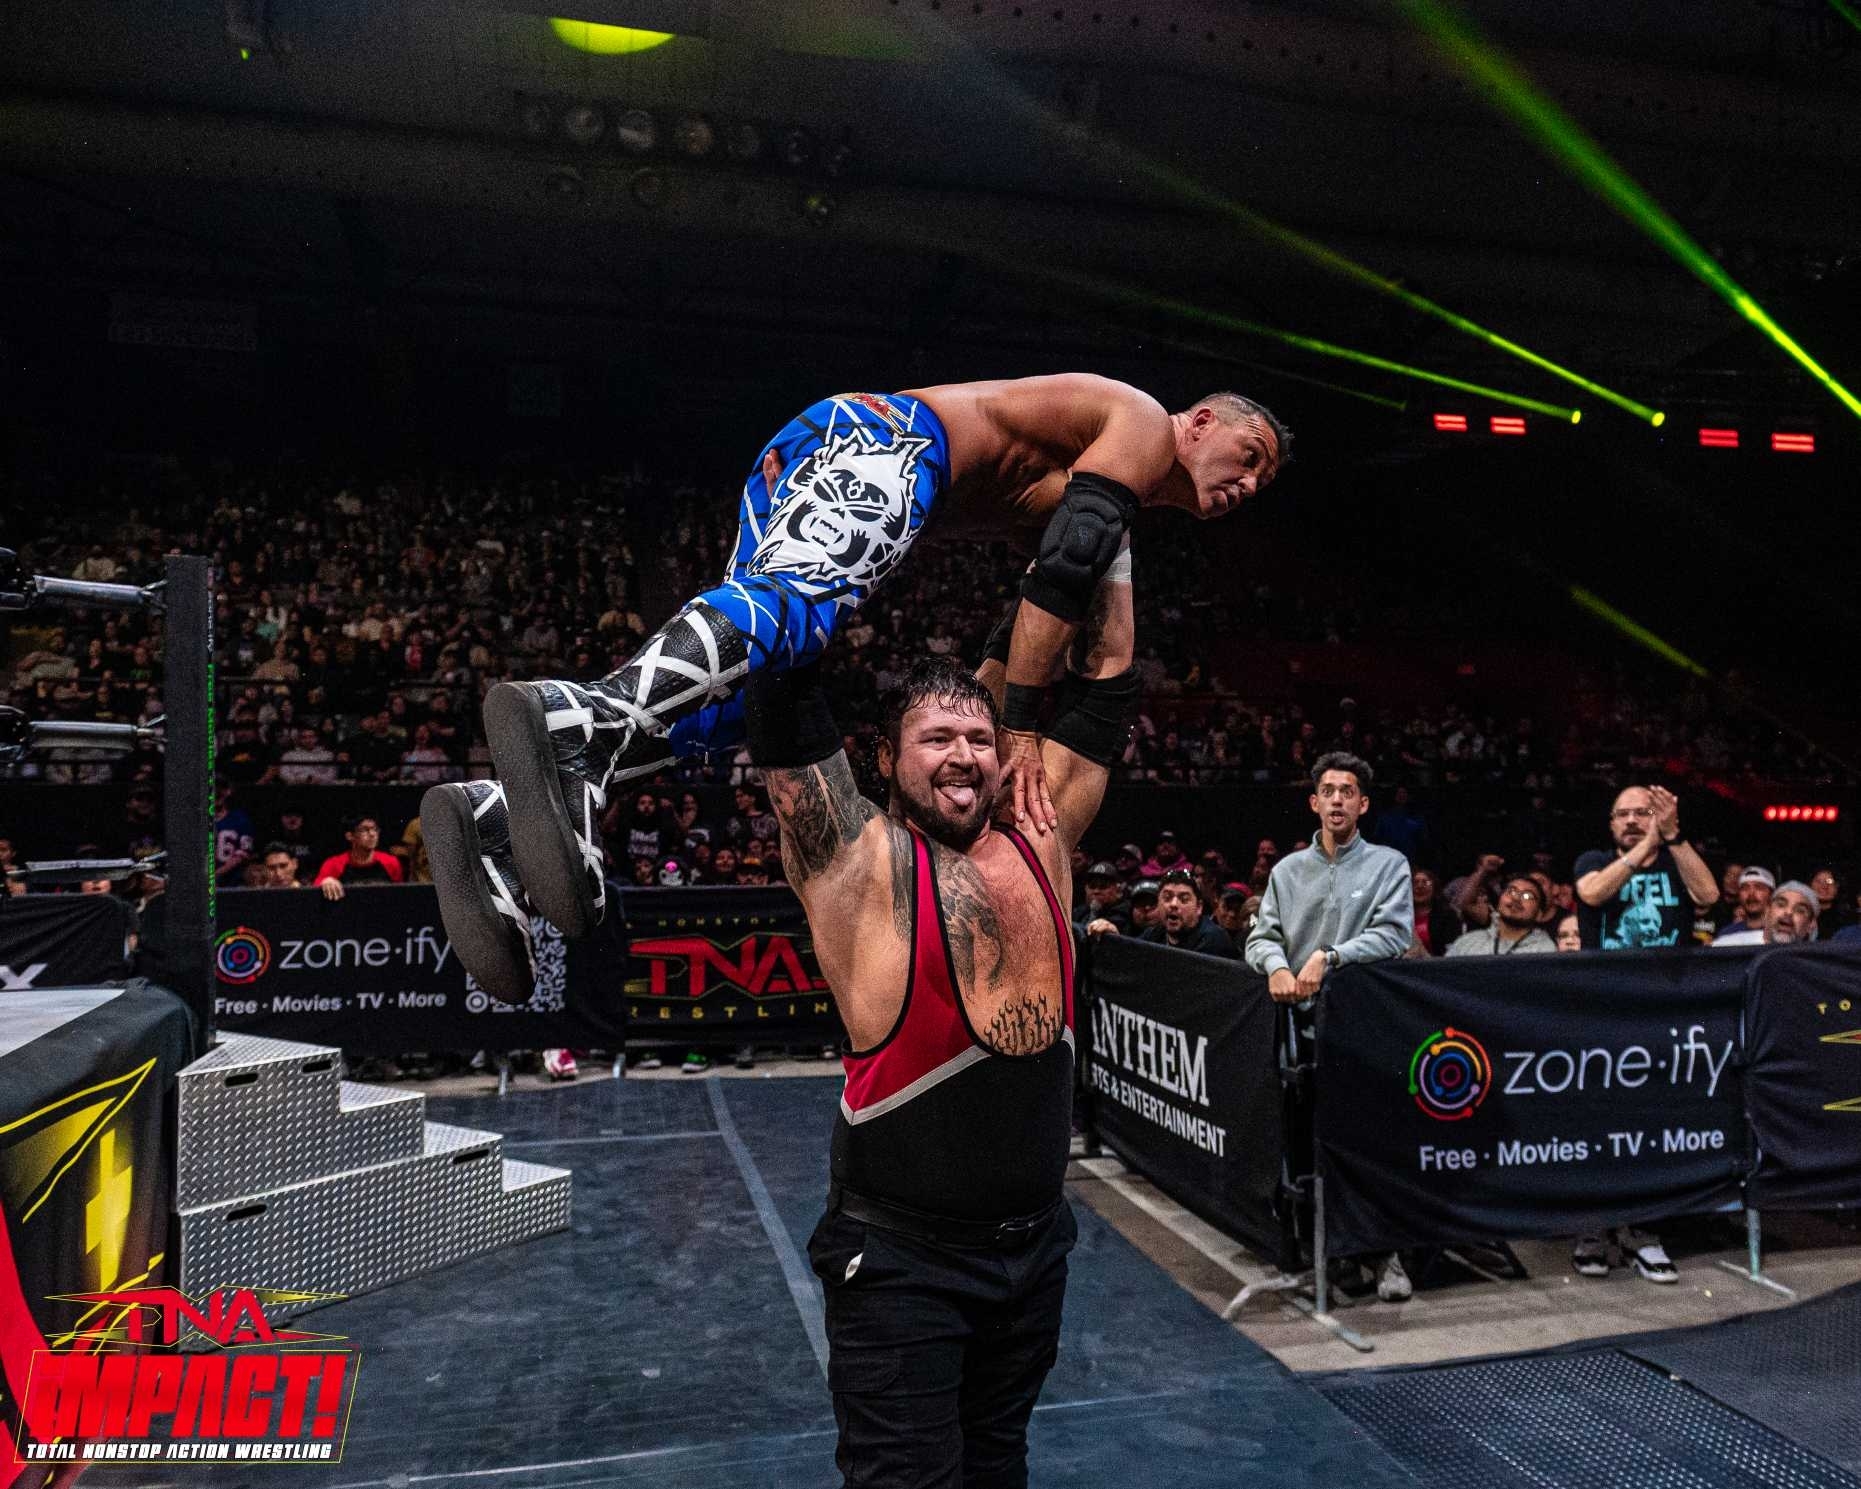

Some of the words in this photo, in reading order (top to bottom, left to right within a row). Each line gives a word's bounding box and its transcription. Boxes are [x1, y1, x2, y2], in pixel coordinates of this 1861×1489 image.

[629, 935, 829, 998] TNA
[214, 996, 258, 1015] Free
[272, 993, 343, 1014] Movies
[356, 992, 385, 1011] TV
[398, 990, 448, 1009] More
[631, 1002, 828, 1019] ESTLIN
[1110, 1073, 1120, 1101] &
[1121, 1079, 1227, 1158] ENTERTAINMENT
[1419, 1145, 1477, 1171] Free
[1498, 1136, 1589, 1166] Movies
[1608, 1131, 1644, 1157] TV
[1663, 1127, 1725, 1154] More
